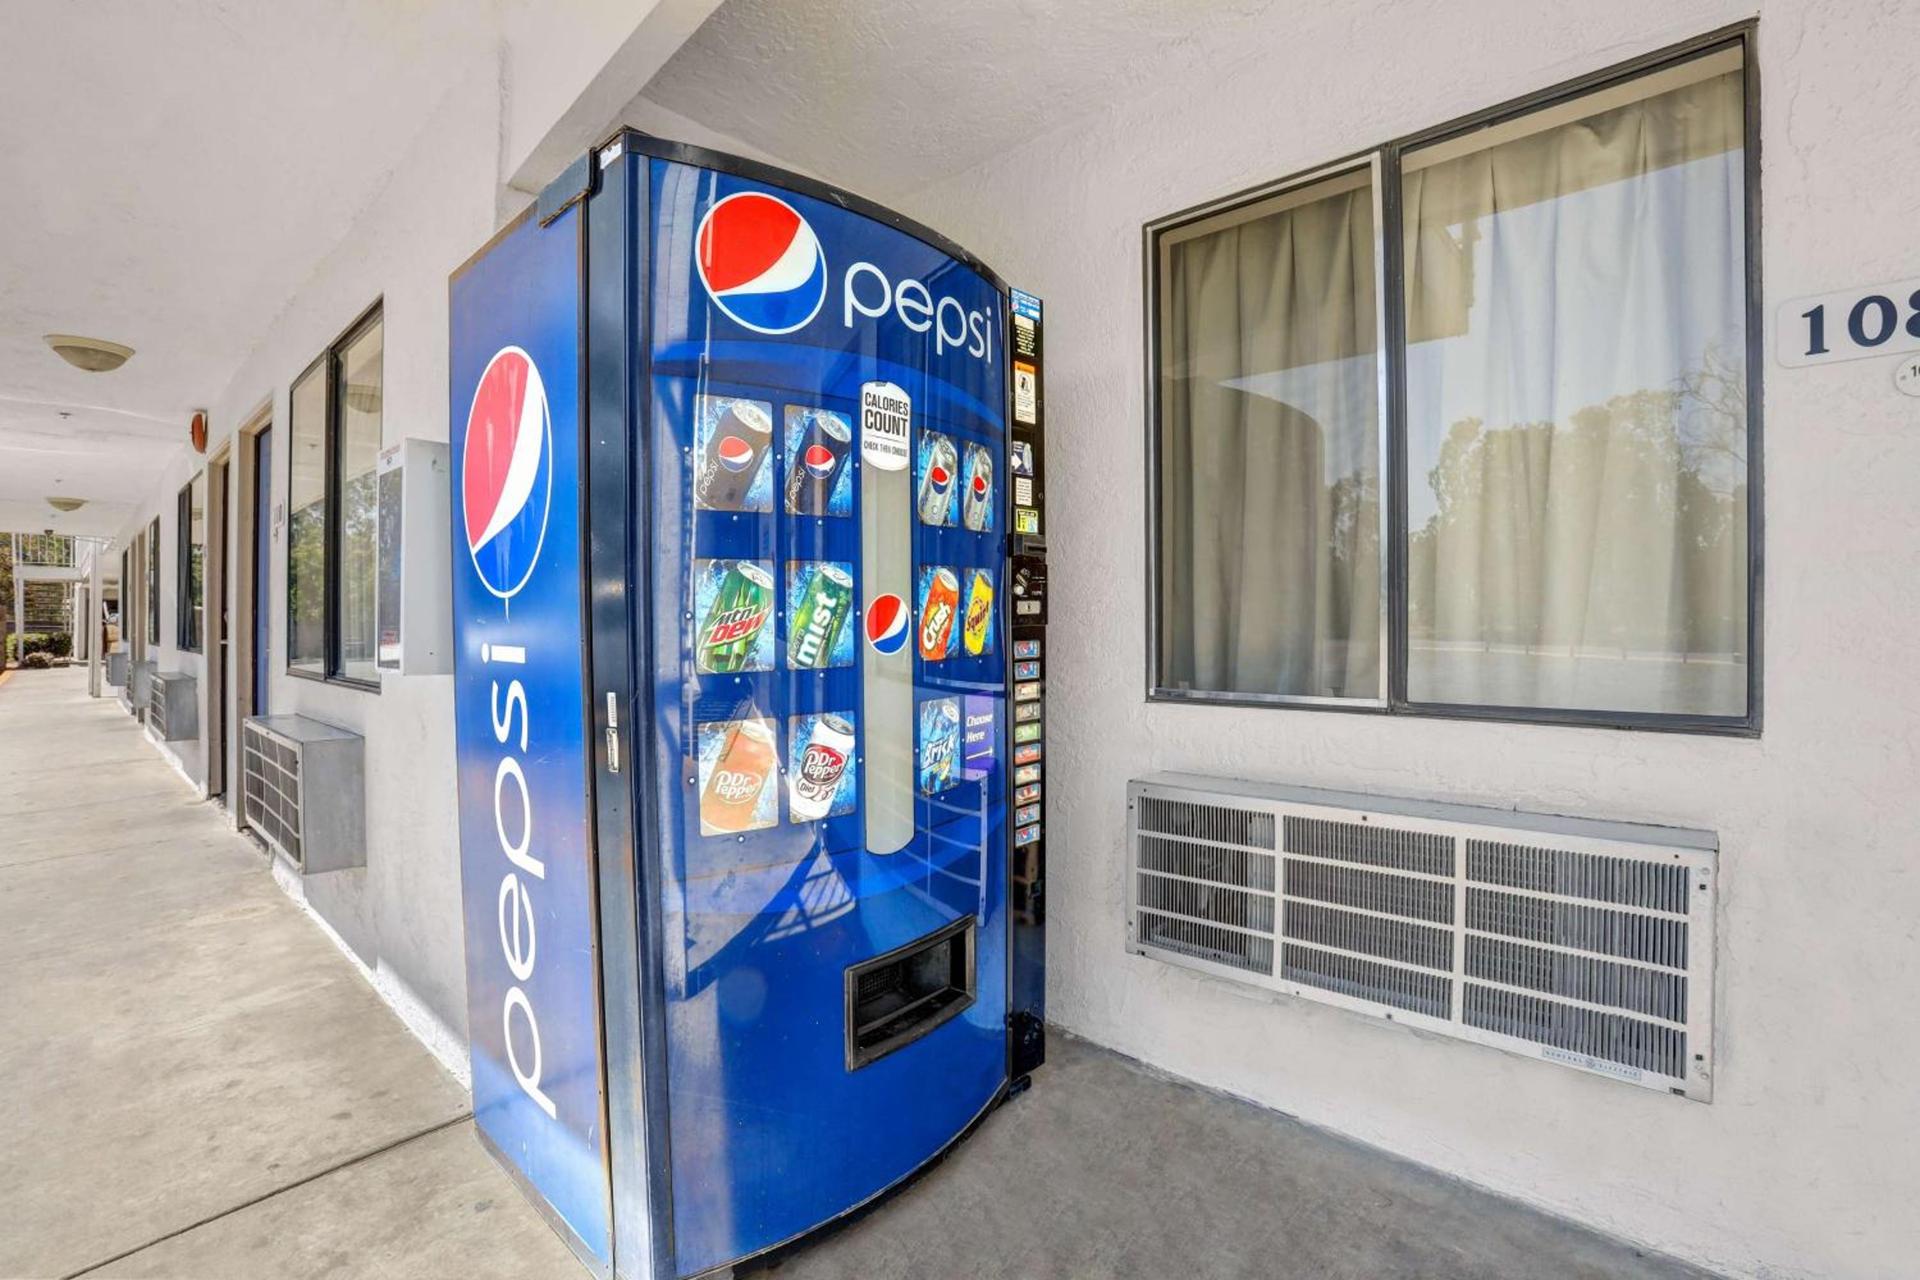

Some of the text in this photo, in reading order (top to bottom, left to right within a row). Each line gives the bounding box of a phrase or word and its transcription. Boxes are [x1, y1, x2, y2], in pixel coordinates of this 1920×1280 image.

[844, 262, 992, 364] pepsi
[865, 392, 908, 416] CALORIES
[865, 409, 908, 437] COUNT
[700, 458, 719, 496] pepsi
[803, 750, 843, 779] Pepper
[819, 752, 837, 768] Dr
[715, 771, 759, 799] Pepper
[731, 773, 752, 787] Dr
[481, 643, 556, 1120] pepsi
